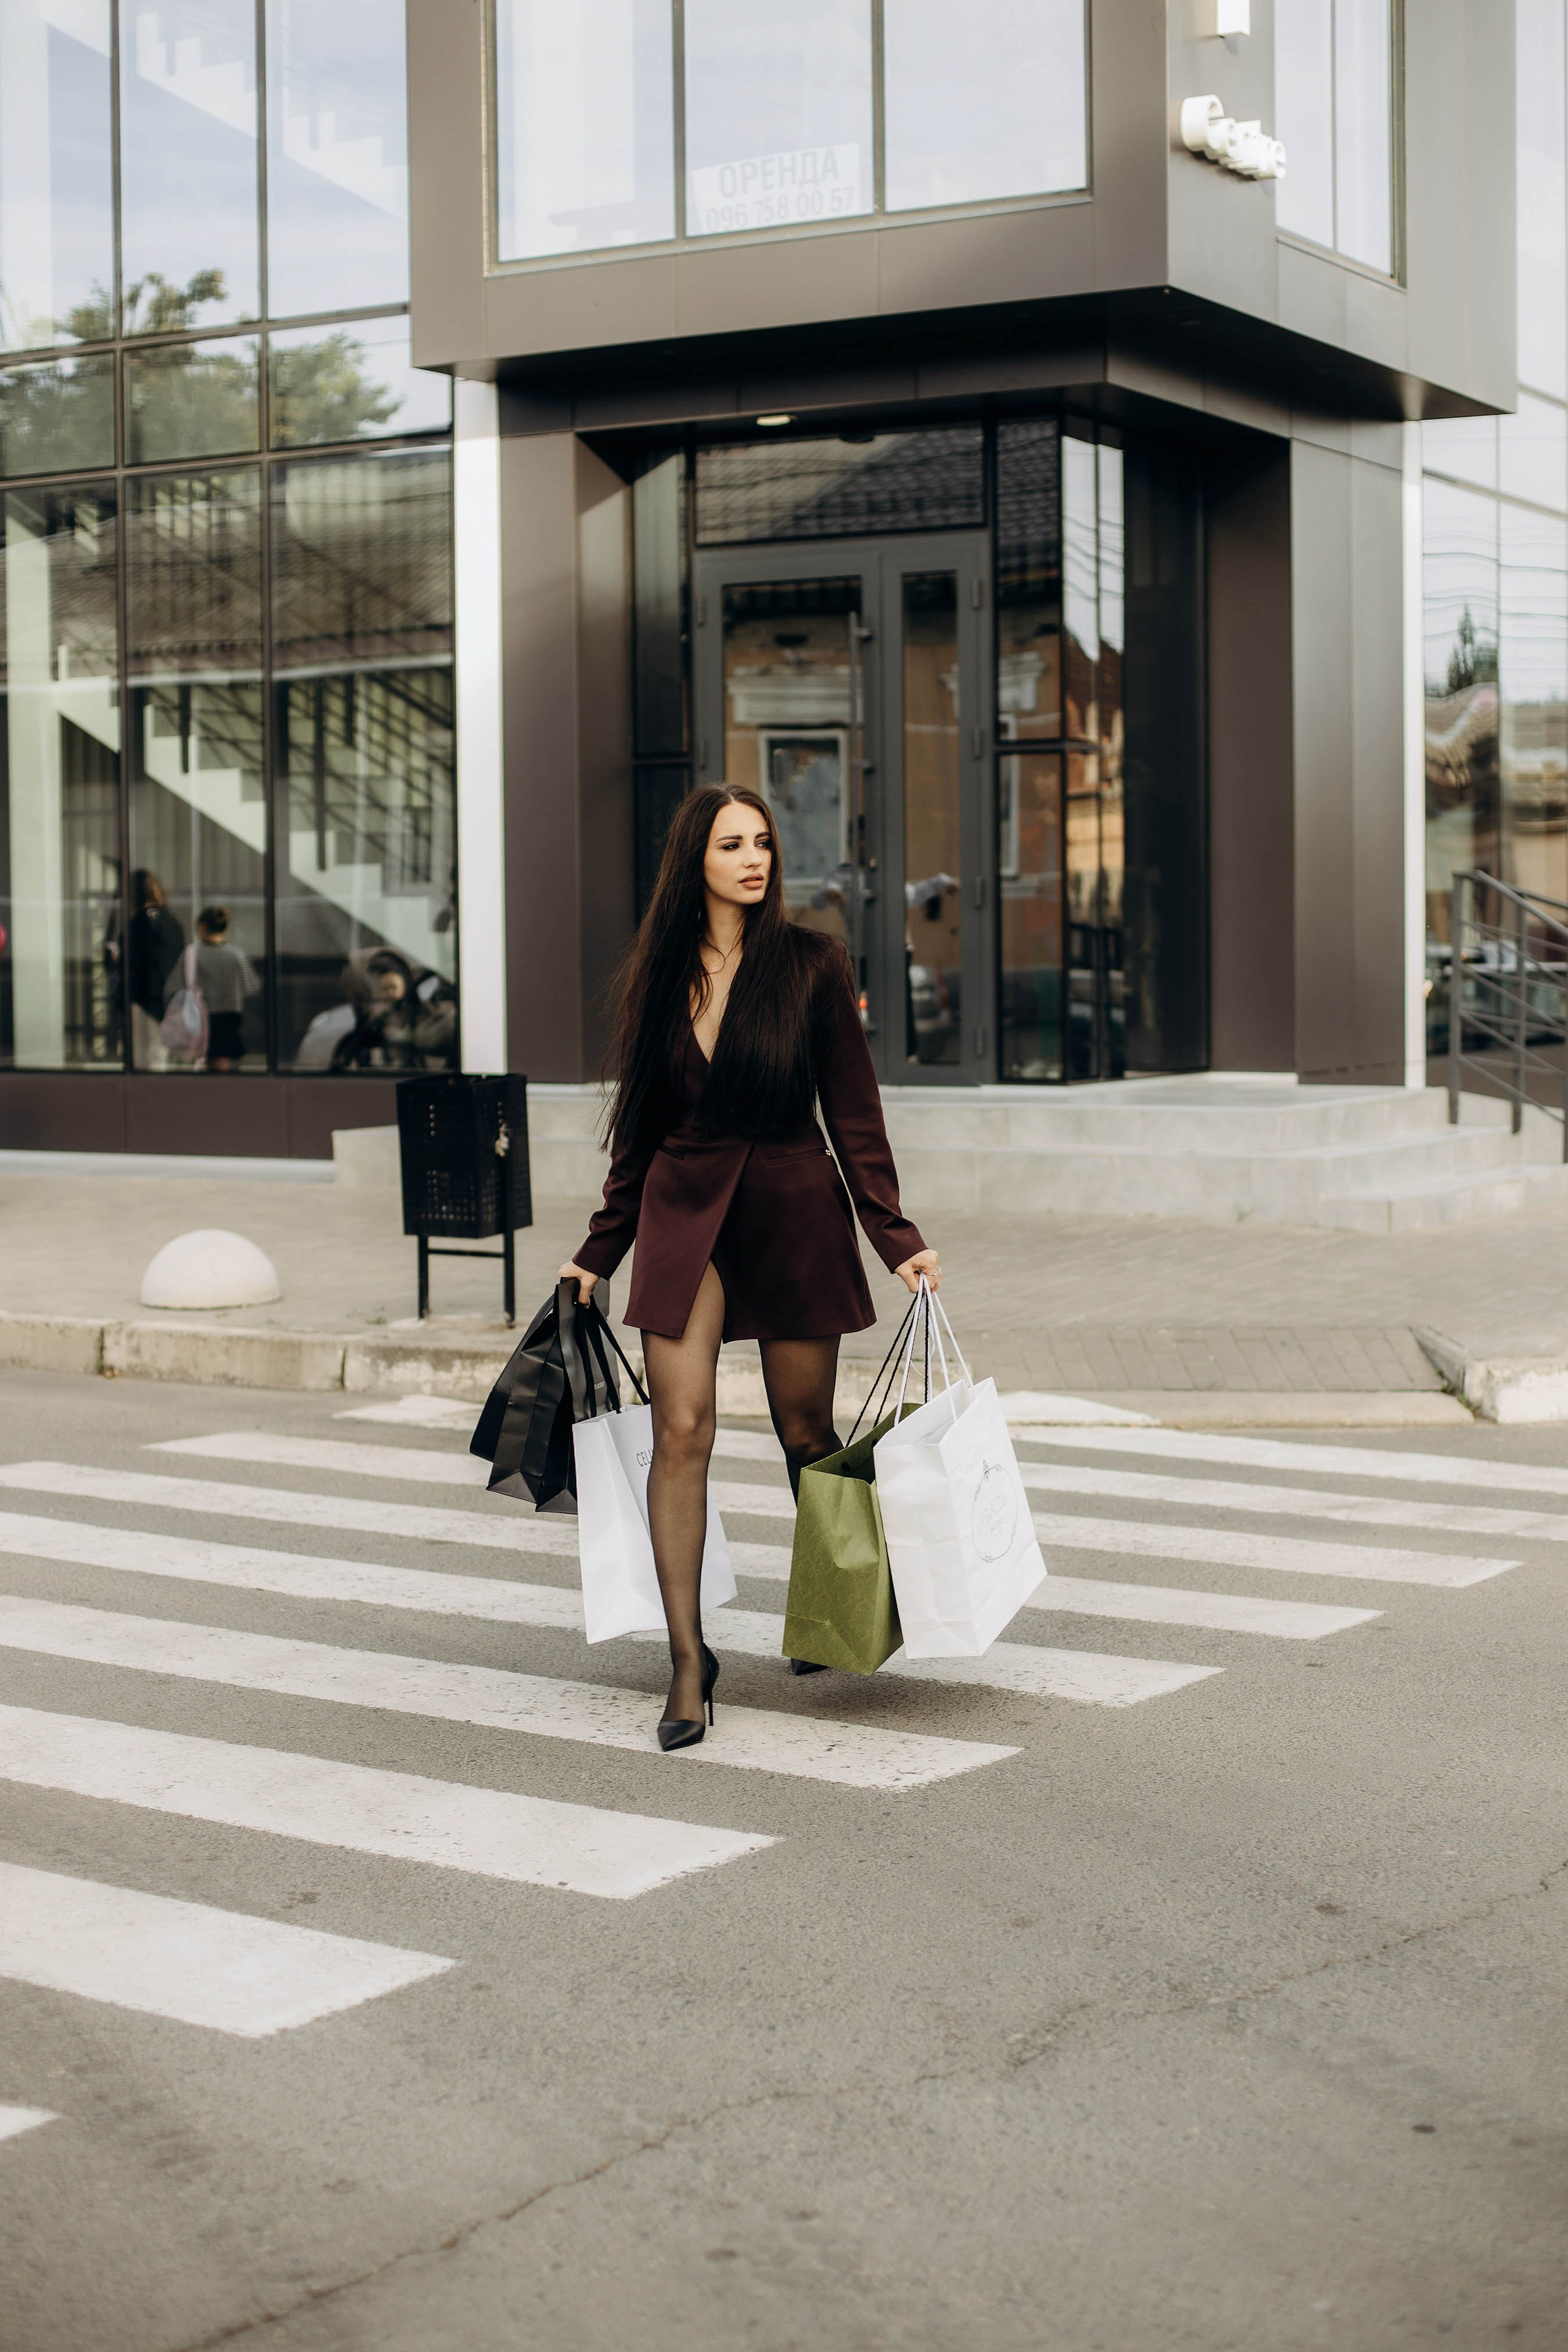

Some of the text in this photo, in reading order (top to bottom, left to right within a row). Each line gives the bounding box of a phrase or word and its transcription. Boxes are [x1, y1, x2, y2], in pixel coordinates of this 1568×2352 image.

[718, 149, 839, 197] ОРЕНДА
[706, 186, 854, 231] 096 758 00 57
[636, 1449, 653, 1466] CELI
